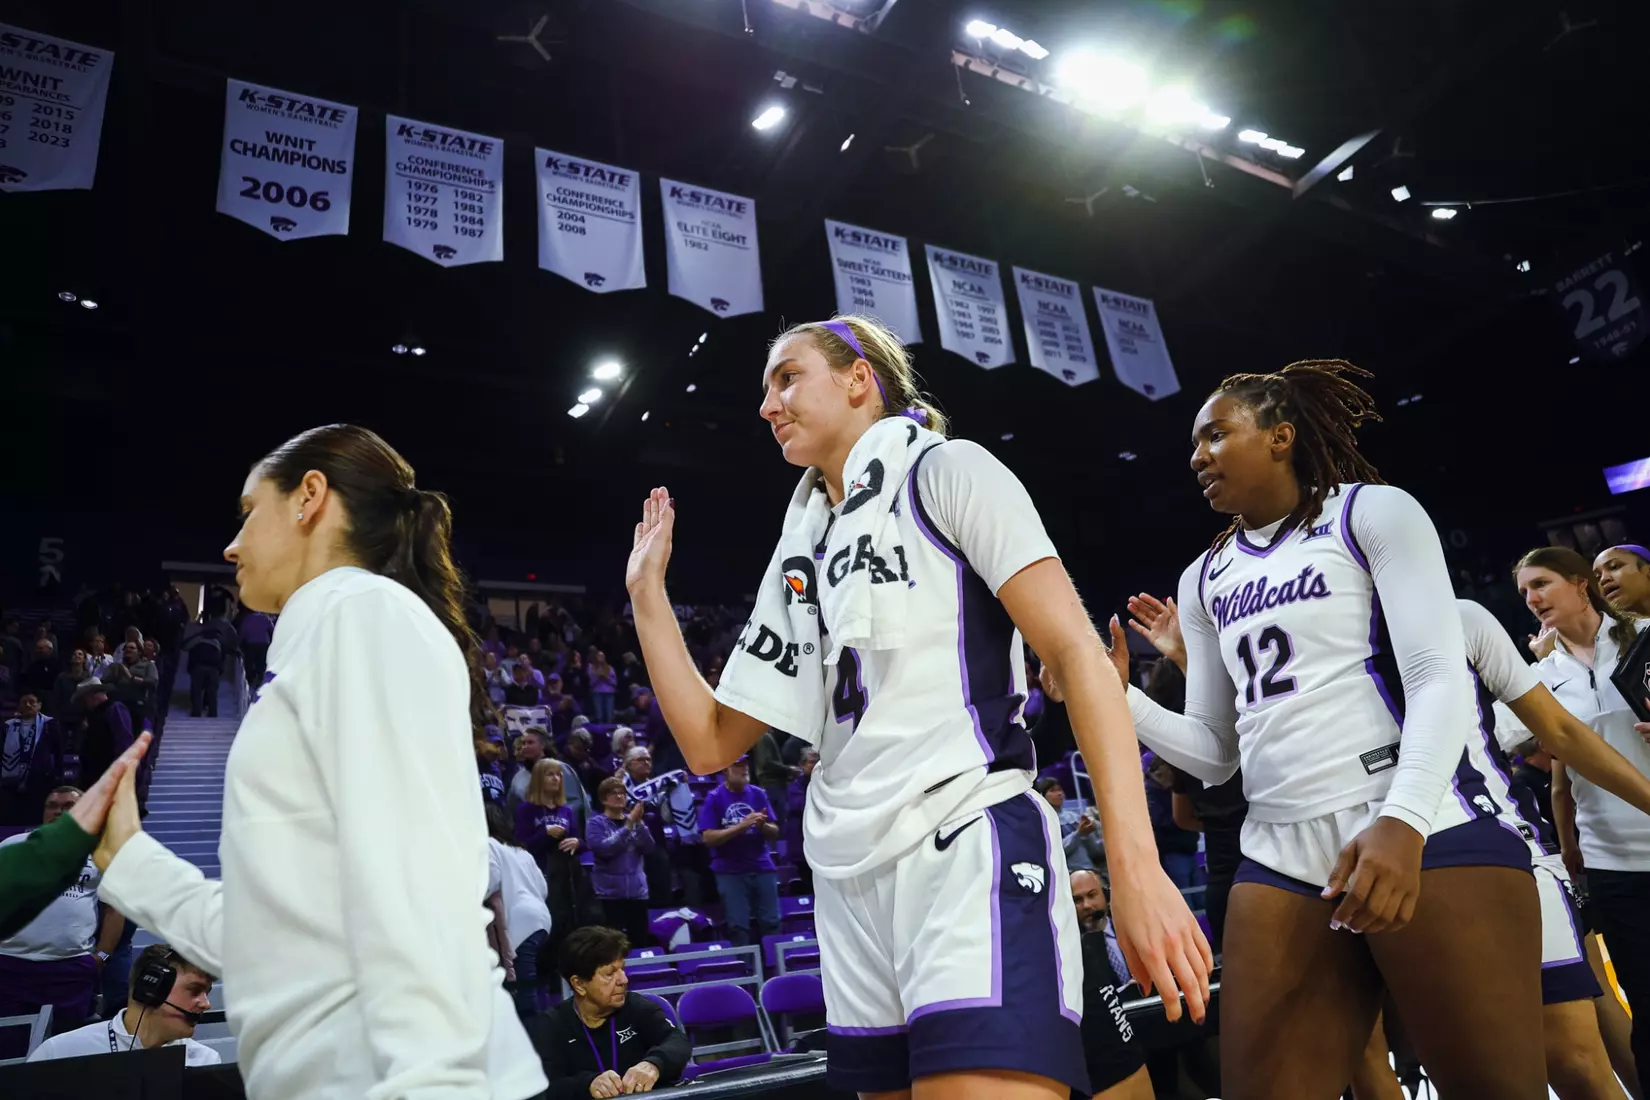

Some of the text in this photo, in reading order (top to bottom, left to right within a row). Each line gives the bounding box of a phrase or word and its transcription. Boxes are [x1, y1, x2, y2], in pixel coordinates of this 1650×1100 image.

[0, 65, 64, 91] WNIT
[32, 102, 75, 121] 2015
[238, 88, 347, 123] K-STATE
[246, 104, 338, 129] WOMEN'S BASKETBALL
[30, 116, 73, 134] 2018
[28, 131, 71, 148] 2023
[265, 130, 317, 152] WNIT
[396, 124, 494, 155] K-STATE
[229, 138, 347, 175] CHAMPIONS
[407, 155, 485, 178] CONFERENCE
[395, 161, 496, 189] CHAMPIONSHIPS
[545, 156, 632, 187] K-STATE
[239, 176, 331, 212] 2006
[406, 180, 483, 203] 1976 1982
[406, 192, 484, 215] 1977 1983
[556, 186, 625, 209] CONFERENCE
[669, 186, 747, 214] K-STATE
[406, 204, 484, 227] 1978 1984
[546, 192, 636, 220] CHAMPIONSHIPS
[557, 210, 586, 224] 2004
[406, 216, 484, 239] 1979 1987
[557, 222, 587, 236] 2008
[677, 221, 747, 245] ELITE EIGHT
[834, 226, 901, 252] K-STATE
[684, 238, 709, 252] 1982
[836, 257, 912, 281] SWEET SIXTEEN
[933, 251, 994, 276] K-STATE
[1555, 252, 1612, 293] BARRETT
[952, 279, 986, 296] NCAA
[1020, 272, 1073, 296] K-STATE
[1562, 269, 1640, 340] 22
[1212, 563, 1332, 633] Wildcats
[1236, 624, 1299, 707] 12
[1099, 984, 1135, 1043] RTANS
